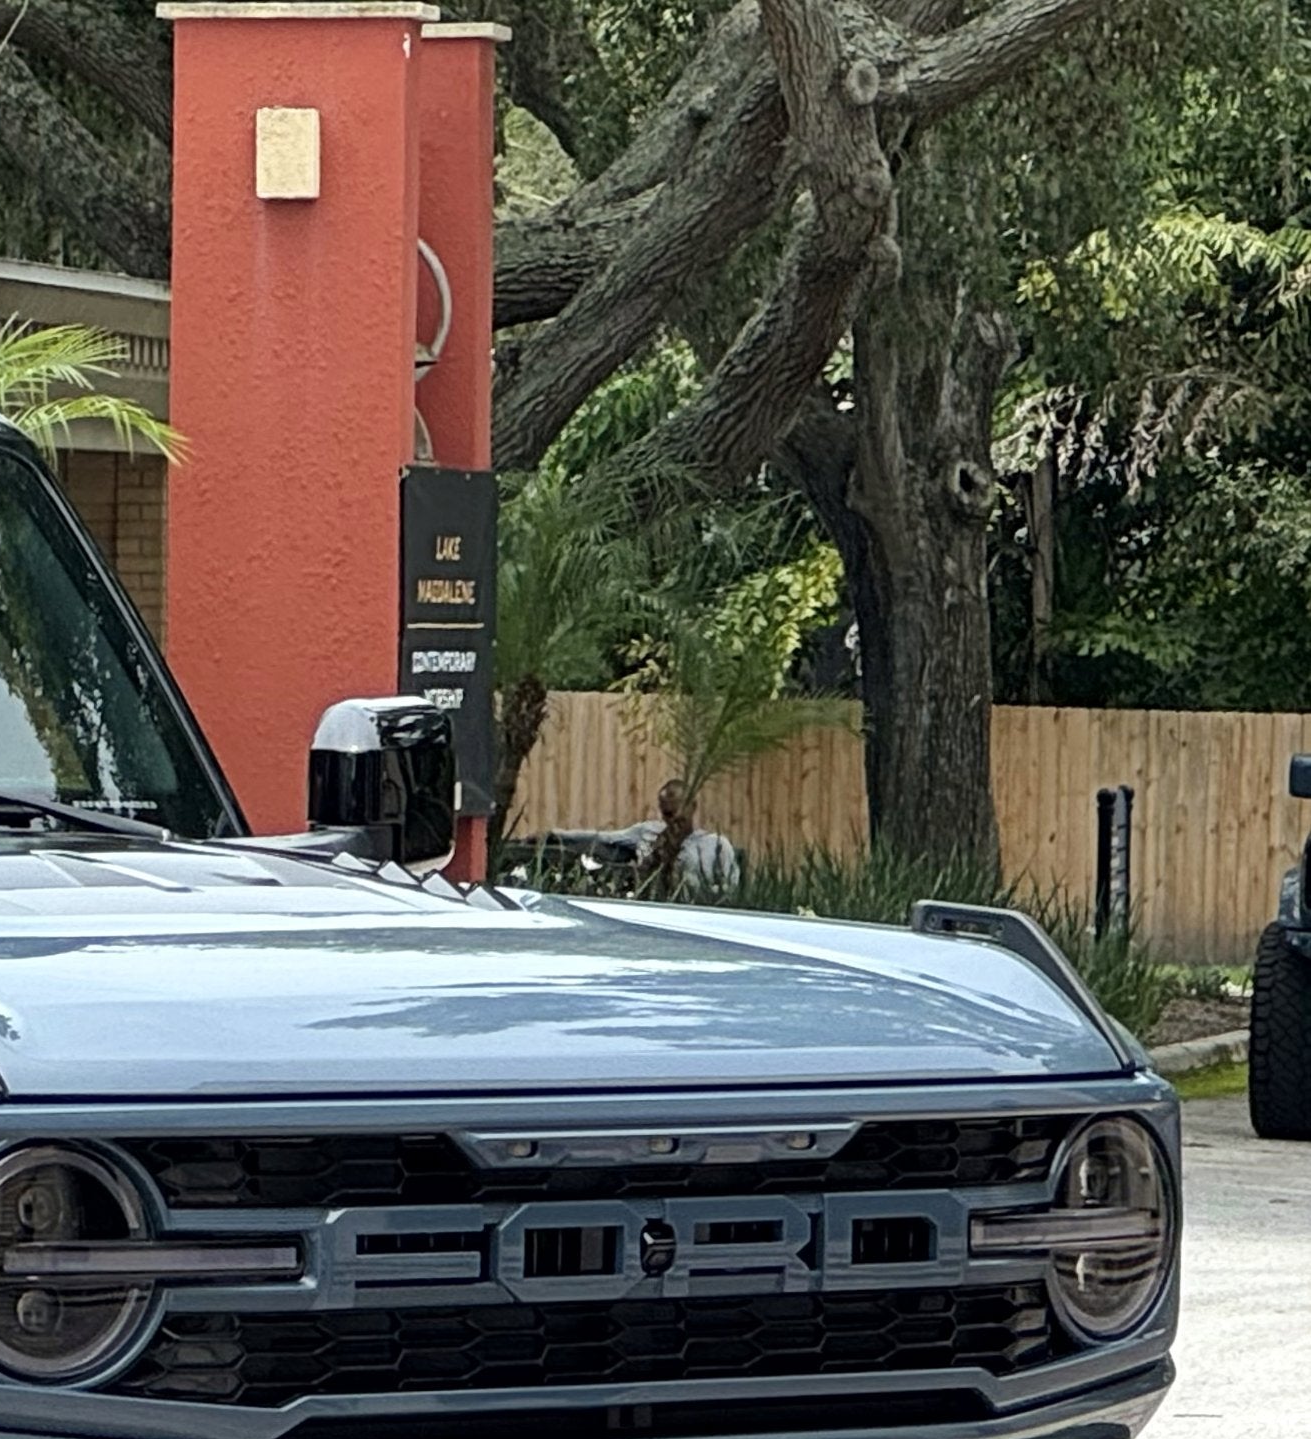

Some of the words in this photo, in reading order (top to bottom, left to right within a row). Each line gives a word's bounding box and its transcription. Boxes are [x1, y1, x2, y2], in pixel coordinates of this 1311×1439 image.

[436, 536, 461, 561] LAKE
[417, 579, 476, 605] MAGDALENE
[322, 1189, 969, 1308] FORD
